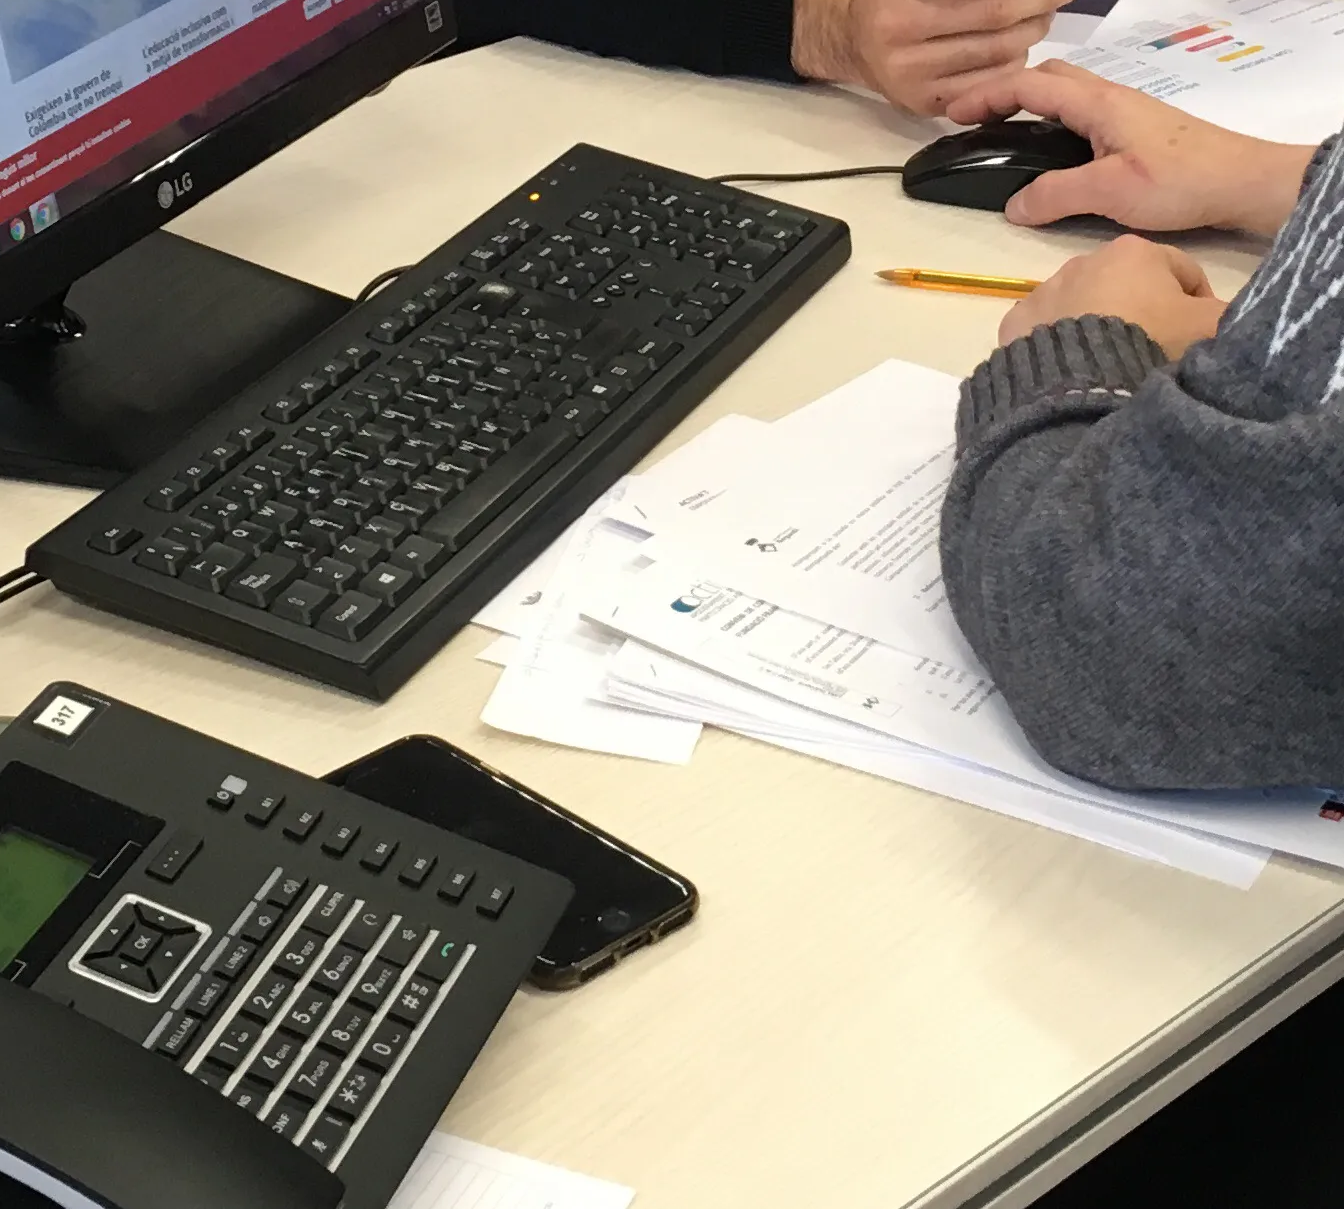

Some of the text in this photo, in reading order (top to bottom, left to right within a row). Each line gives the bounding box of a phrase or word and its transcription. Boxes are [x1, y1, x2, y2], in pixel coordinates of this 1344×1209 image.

[62, 87, 72, 102] al
[99, 66, 111, 82] de
[66, 98, 84, 120] que
[173, 171, 193, 197] LG
[284, 487, 301, 497] E
[257, 505, 276, 517] W
[232, 528, 249, 538] Q
[364, 523, 382, 533] X
[339, 543, 356, 554] Z
[51, 704, 76, 727] 317
[133, 934, 152, 951] OK
[223, 944, 249, 970] LINE 2
[285, 950, 306, 966] 3
[322, 967, 341, 982] 6
[253, 981, 286, 1010] 2 ABC
[361, 981, 380, 995] 9
[197, 988, 216, 1007] LINE
[291, 1009, 312, 1025] 5
[331, 1015, 363, 1042] 8 TUV
[219, 1039, 239, 1053] 1
[372, 1041, 392, 1056] 0
[262, 1043, 292, 1070] 4 GHI
[297, 1072, 318, 1088] 7
